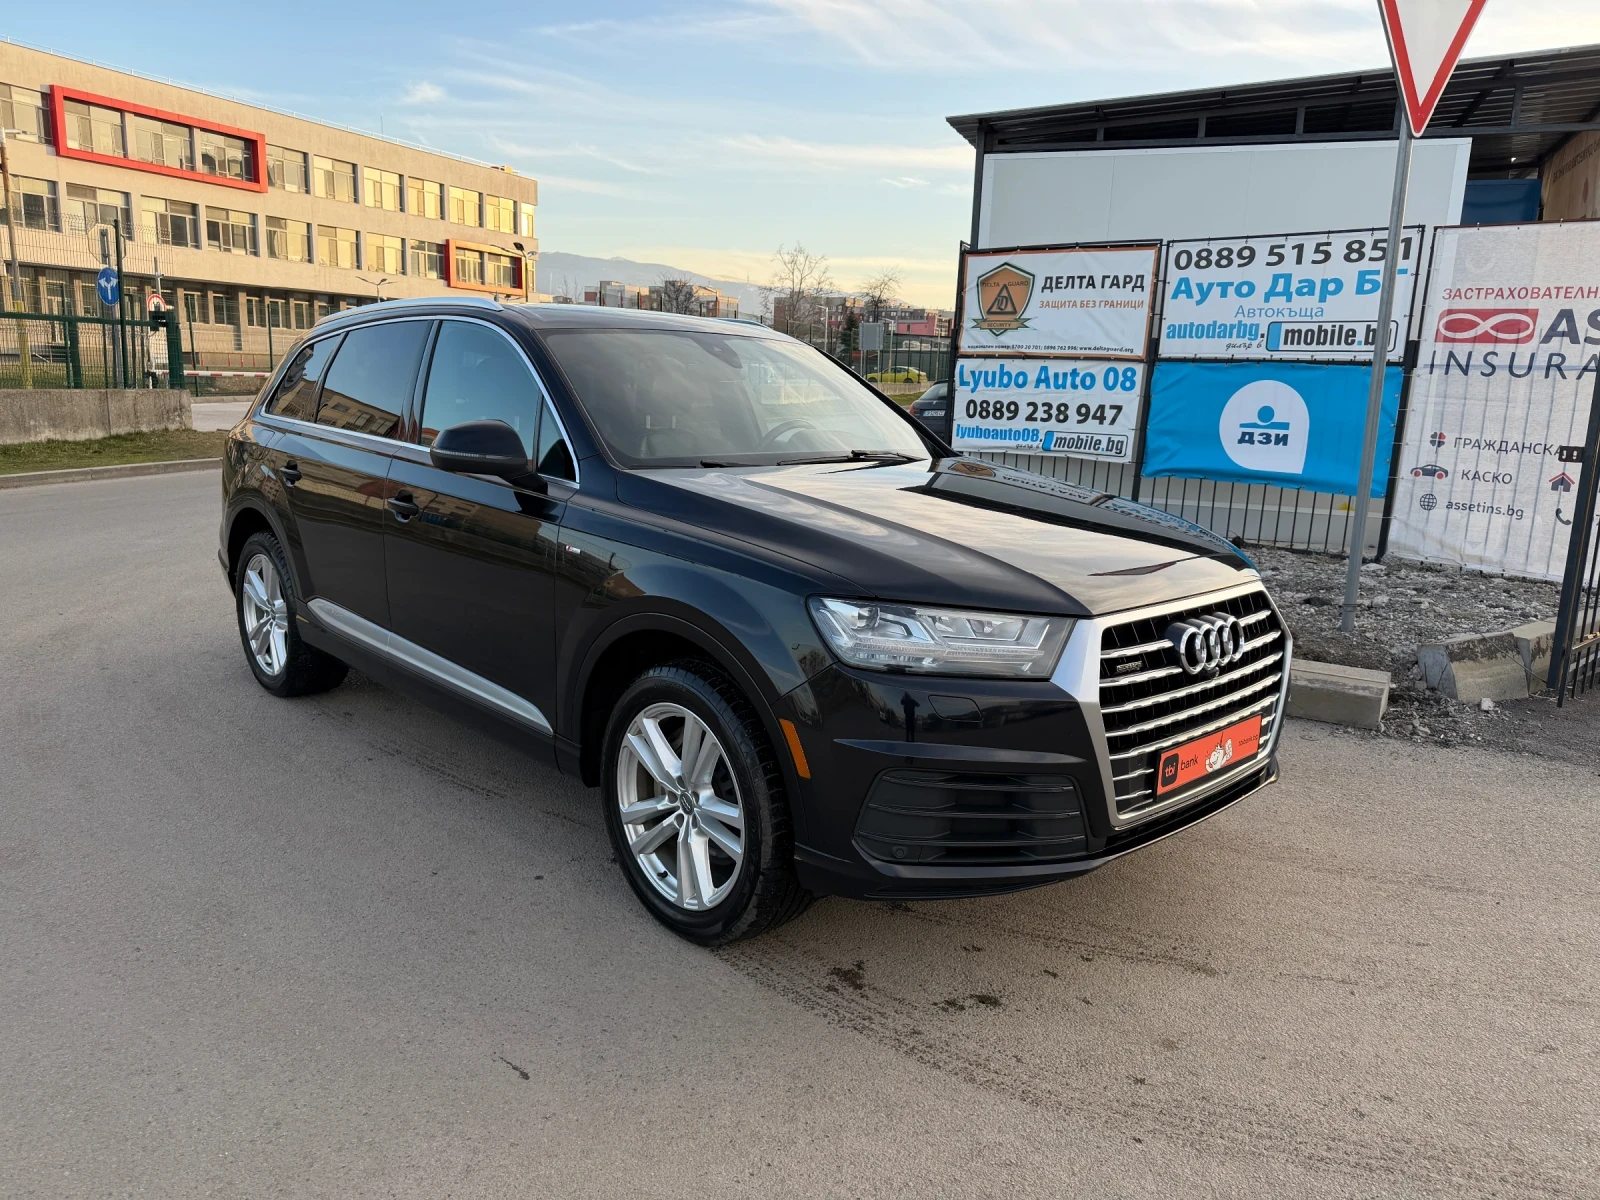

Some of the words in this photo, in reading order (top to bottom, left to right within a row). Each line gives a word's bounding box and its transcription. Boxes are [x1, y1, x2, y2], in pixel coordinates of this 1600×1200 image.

[1174, 245, 1256, 271] 0889
[1265, 241, 1332, 267] 515
[1343, 236, 1413, 263] 851
[1041, 275, 1097, 293] ДЕЛТА
[1100, 274, 1145, 292] ГАРД
[1171, 277, 1256, 306] Ауто
[1263, 273, 1344, 303] Дар
[1355, 268, 1409, 296] Б
[1442, 286, 1600, 300] ЗАСТРАХОВАТЕЛН
[1039, 300, 1078, 310] ЗАЩИТА
[1079, 300, 1097, 308] БЕЗ
[1098, 300, 1144, 309] ГРАНИЦИ
[1234, 304, 1324, 320] Автокъща
[1283, 324, 1392, 346] mobile.b
[958, 364, 1029, 393] Lyubo
[1034, 365, 1096, 390] Auto
[1103, 366, 1137, 392] 08
[965, 399, 1020, 420] 0889
[1025, 401, 1070, 424] 238
[1075, 403, 1123, 425] 947
[1053, 435, 1124, 454] mobile.bg
[1461, 469, 1513, 484] КАСКО
[1445, 501, 1525, 521] assetins.bg
[1164, 762, 1177, 777] tbi
[1180, 754, 1199, 771] bank
